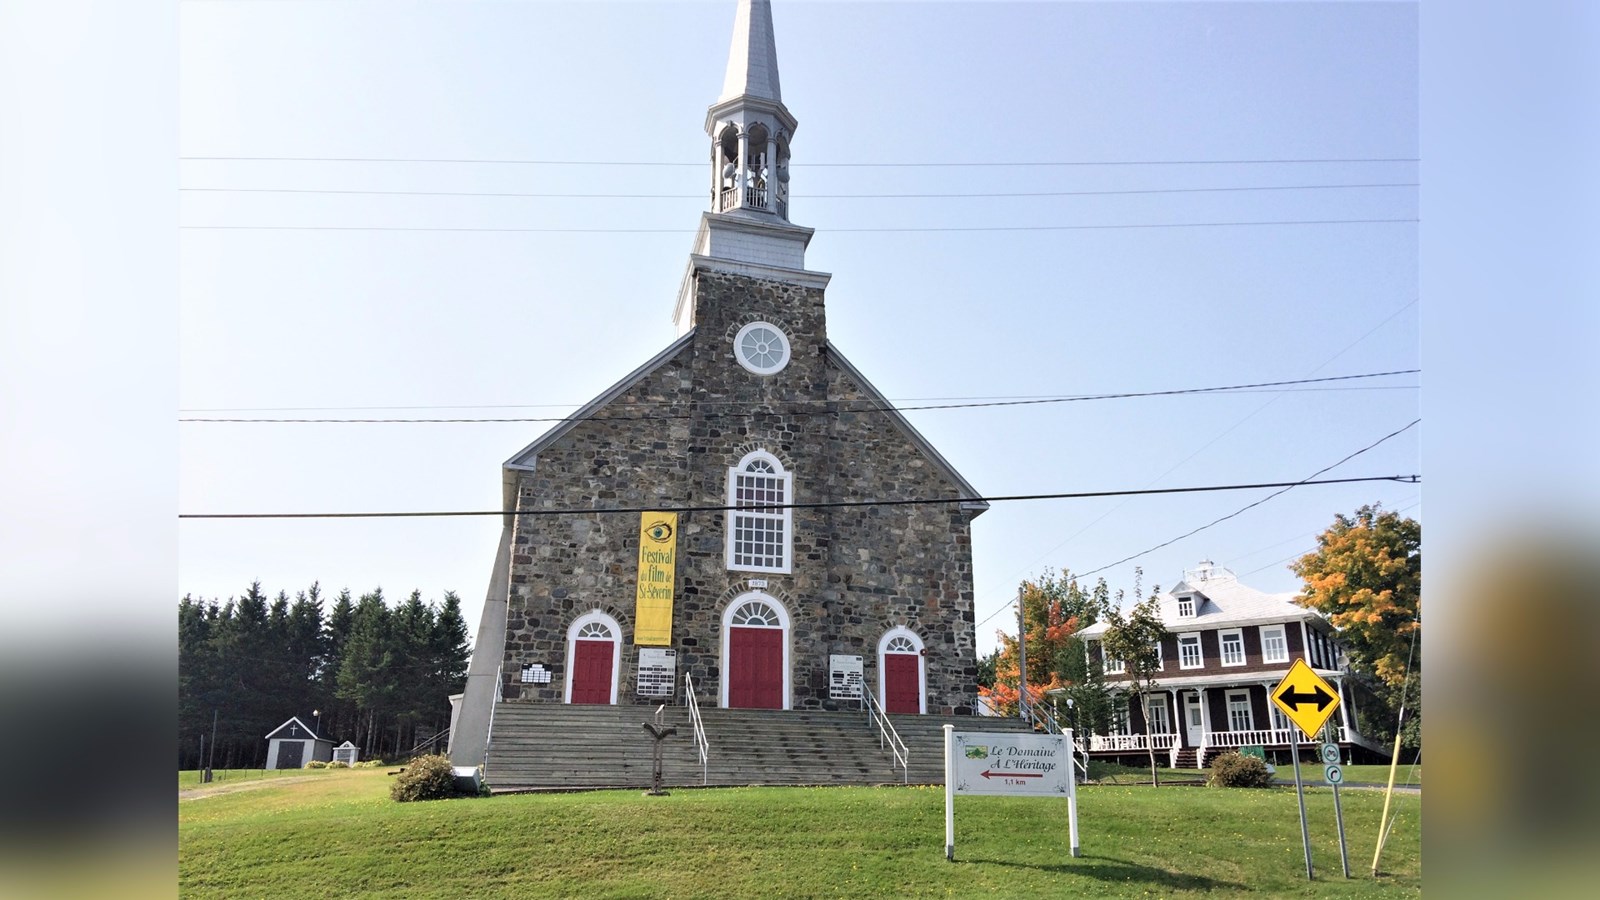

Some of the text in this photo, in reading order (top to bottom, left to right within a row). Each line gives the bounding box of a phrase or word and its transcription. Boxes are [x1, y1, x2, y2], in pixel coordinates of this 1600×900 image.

[642, 546, 673, 564] Festival
[648, 564, 665, 582] film
[990, 746, 1055, 757] Le Domaine
[991, 757, 1056, 772] À L'Héritage
